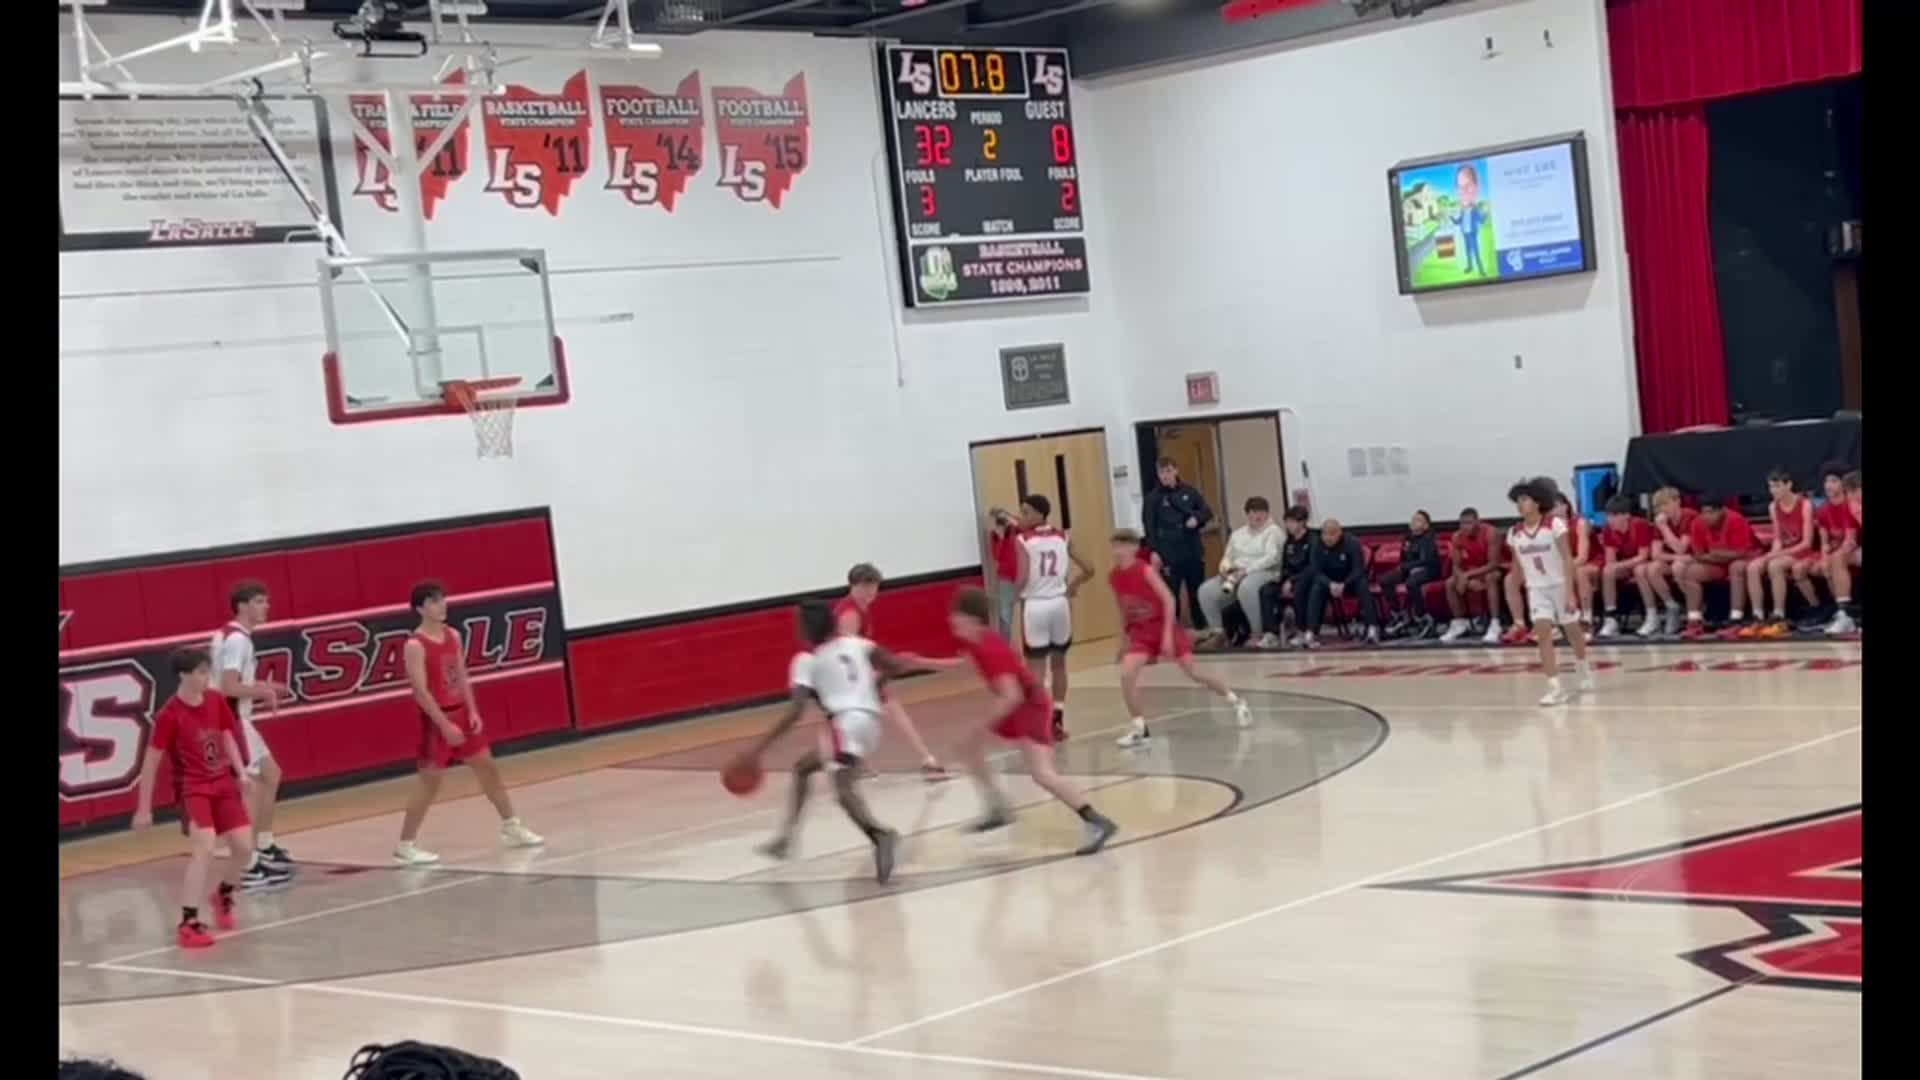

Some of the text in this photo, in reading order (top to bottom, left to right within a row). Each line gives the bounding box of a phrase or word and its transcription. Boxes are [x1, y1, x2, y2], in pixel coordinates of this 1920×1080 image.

[899, 51, 932, 94] LS
[1032, 54, 1064, 95] LS
[354, 103, 387, 118] TRA
[484, 100, 587, 116] BASKETBALL
[606, 98, 699, 116] FOOTBALL
[718, 99, 804, 116] FOOTBALL
[897, 100, 957, 119] LANCERS
[970, 111, 1003, 125] PERIOD
[1025, 101, 1065, 119] GUEST
[914, 125, 952, 165] 32
[983, 129, 997, 160] 2
[1051, 124, 1072, 164] 8
[484, 146, 542, 208] LS
[604, 143, 660, 205] LS
[716, 144, 768, 202] LS
[905, 169, 935, 183] FOULS
[965, 168, 1023, 182] PLAYER FOUL
[920, 186, 936, 216] 3
[1061, 182, 1075, 211] 2
[979, 241, 1064, 258] BASKETBALL
[963, 258, 1083, 277] STATE CHAMPIONS
[1040, 550, 1058, 577] 12
